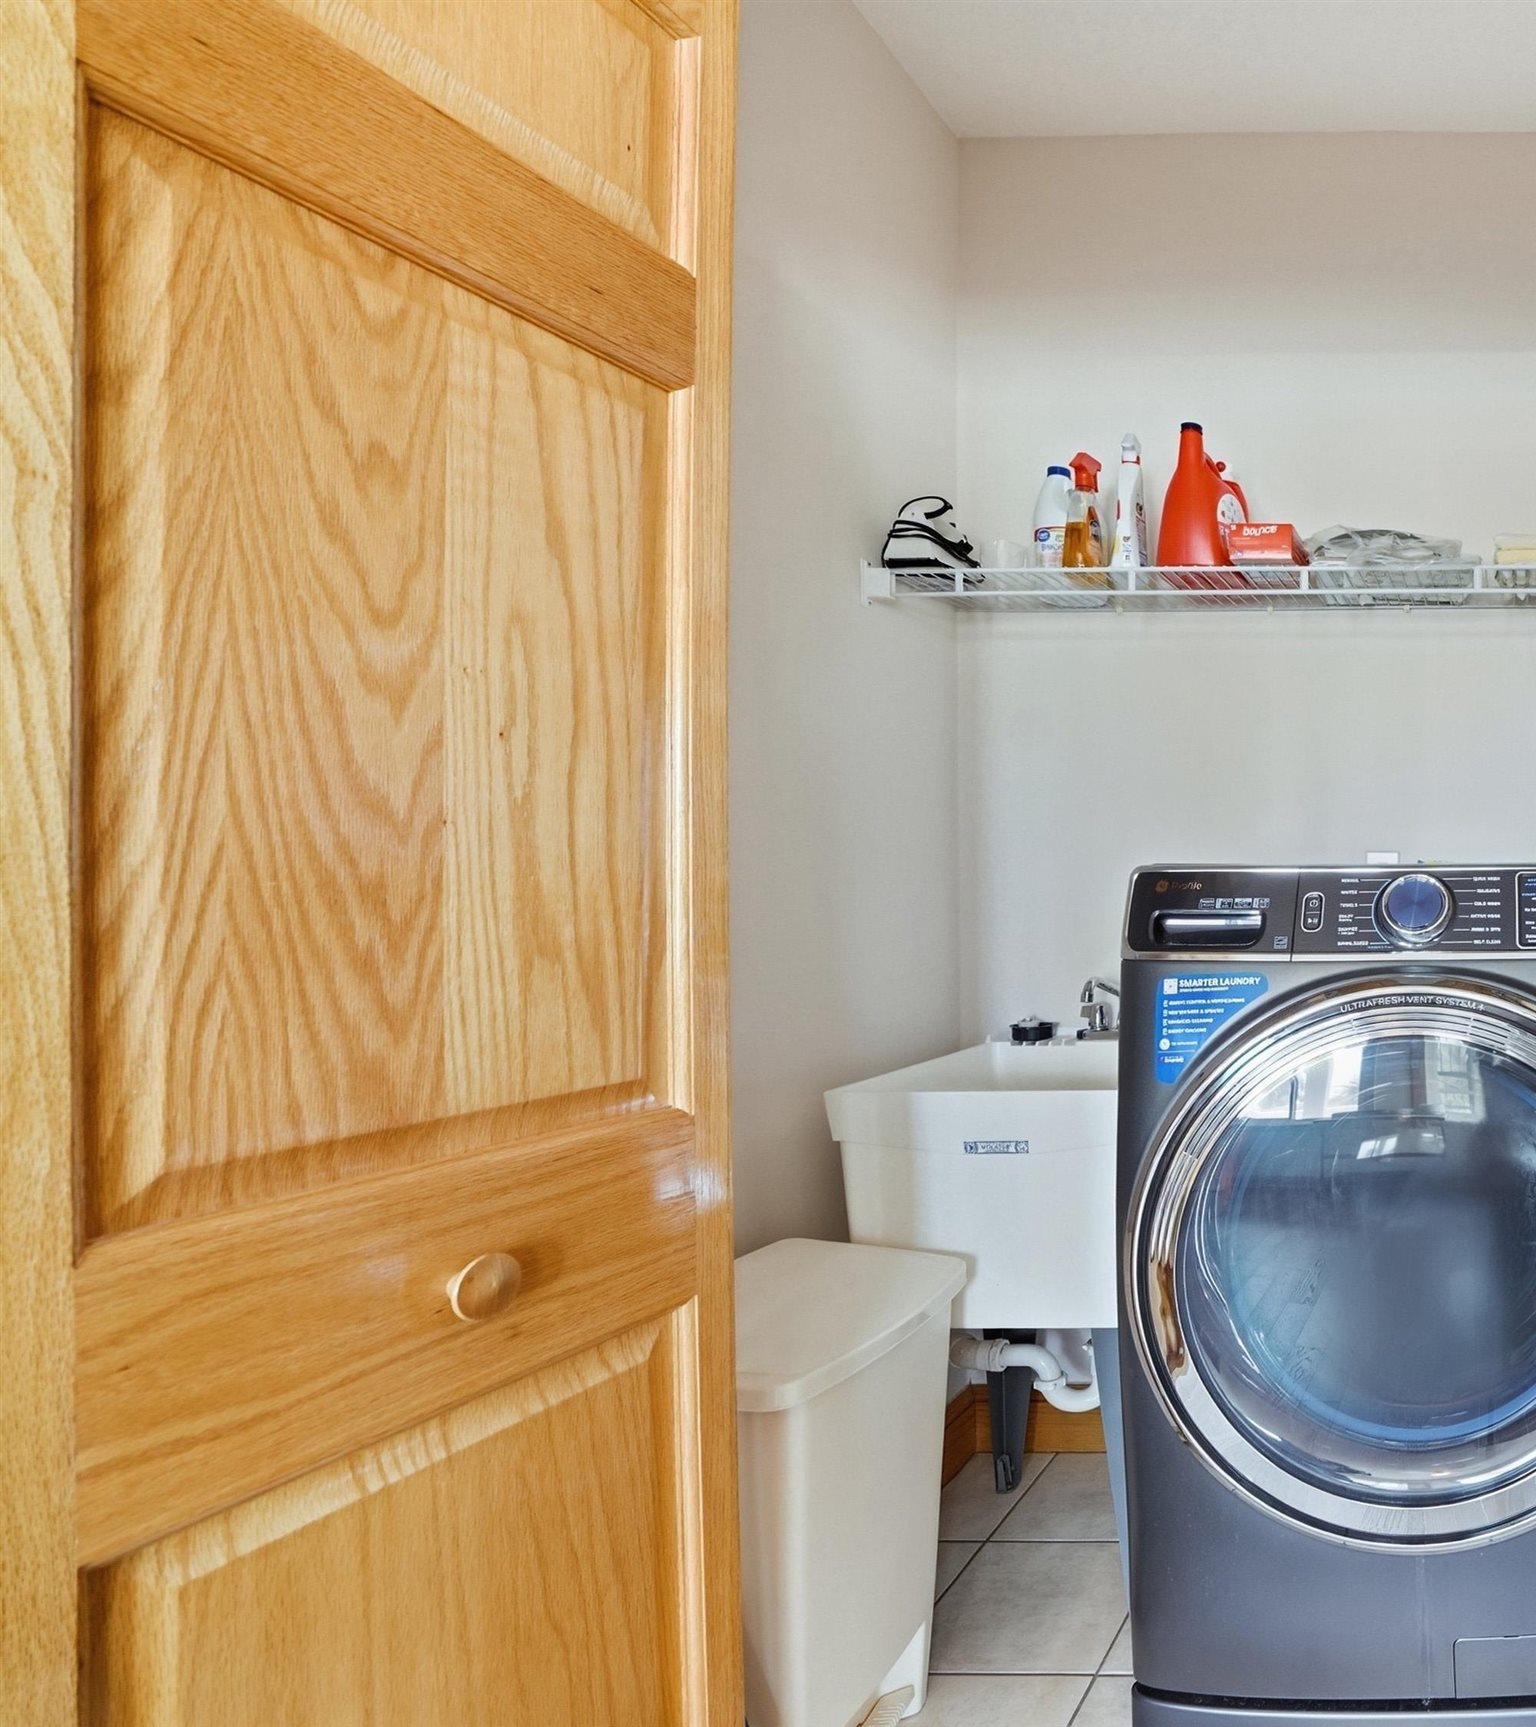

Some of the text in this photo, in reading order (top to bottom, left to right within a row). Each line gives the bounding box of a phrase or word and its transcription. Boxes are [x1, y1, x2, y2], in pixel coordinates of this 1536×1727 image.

[1179, 977, 1261, 987] SMARTER LAUNDRY
[1340, 996, 1405, 1012] ULTRAFRESH
[1406, 995, 1433, 1004] VENT
[1435, 996, 1476, 1010] SYSTEM
